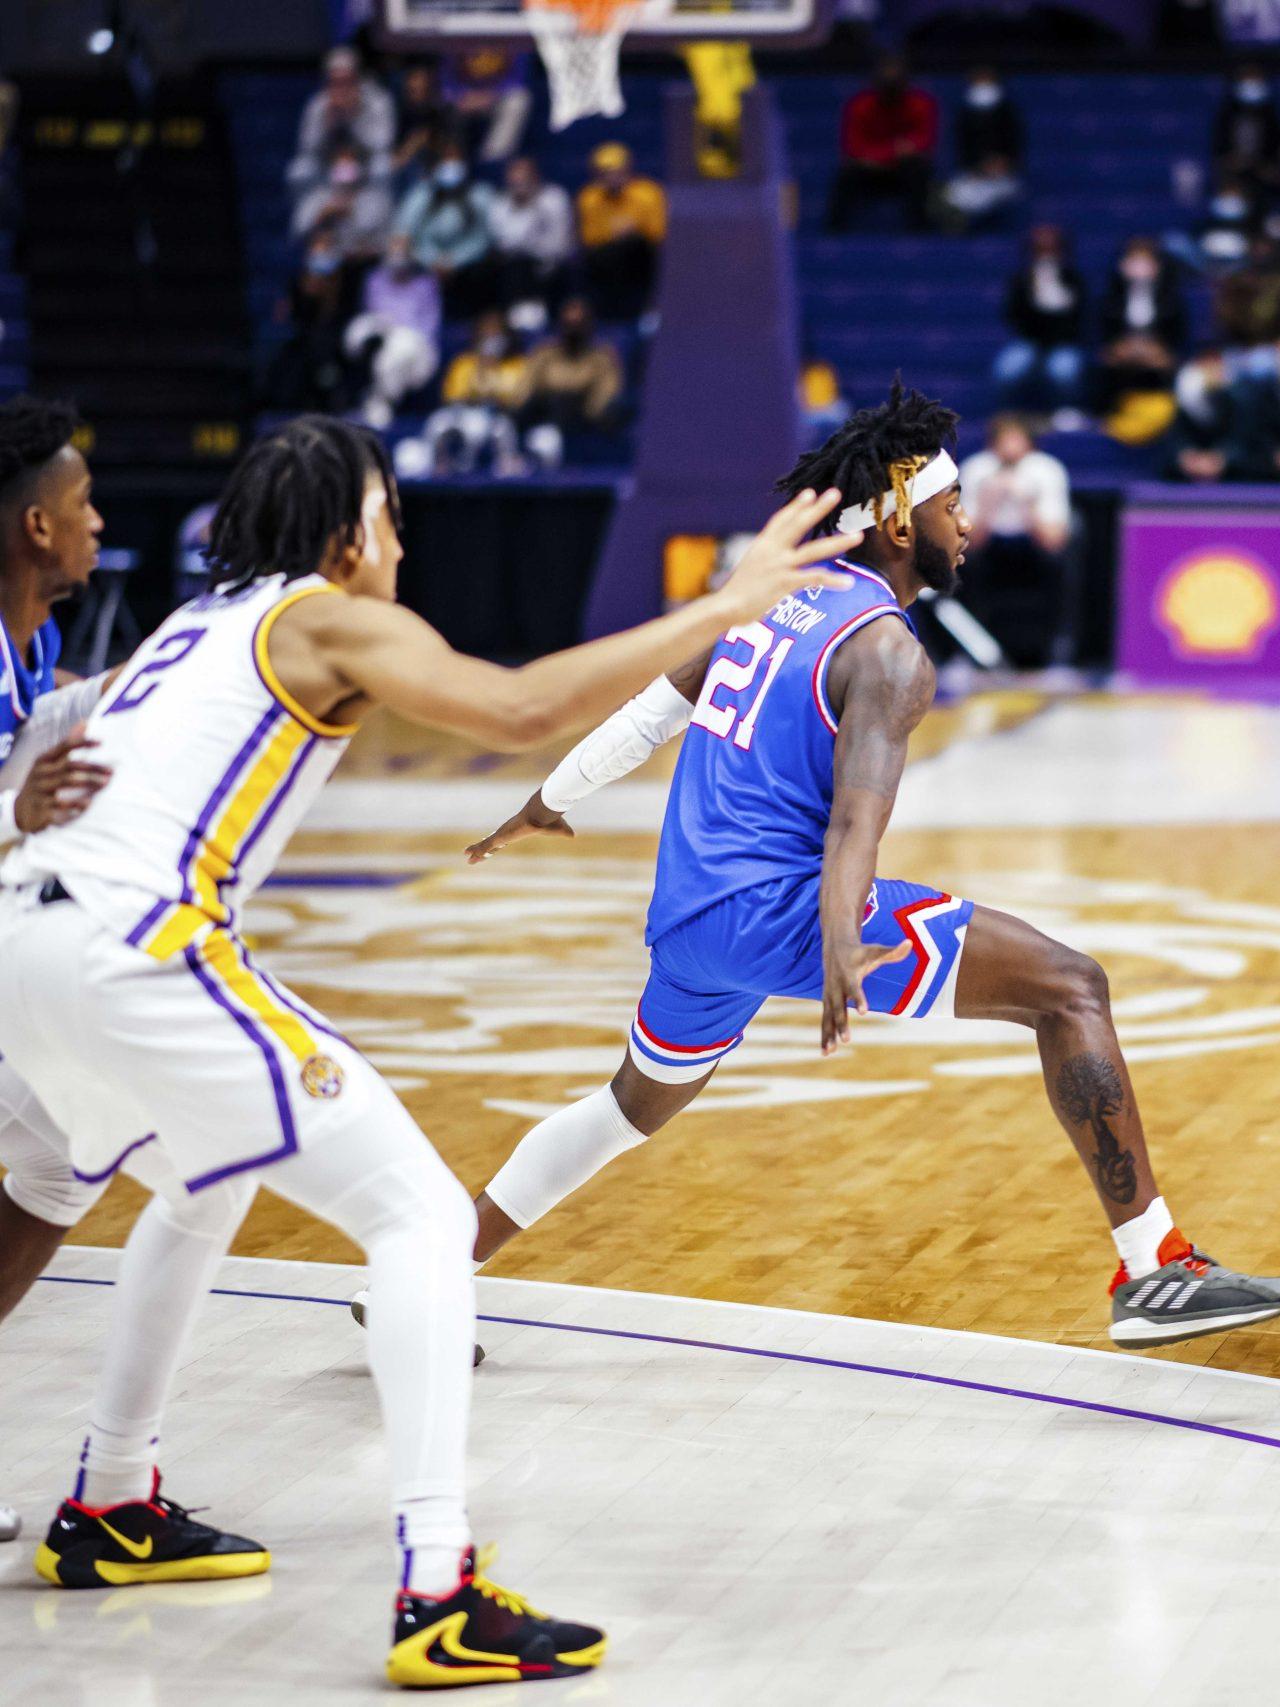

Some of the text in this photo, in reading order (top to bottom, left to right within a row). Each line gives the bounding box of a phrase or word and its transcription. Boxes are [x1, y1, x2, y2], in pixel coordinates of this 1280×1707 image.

[766, 594, 828, 635] RISTON
[102, 627, 208, 717] 2
[690, 621, 796, 752] 21
